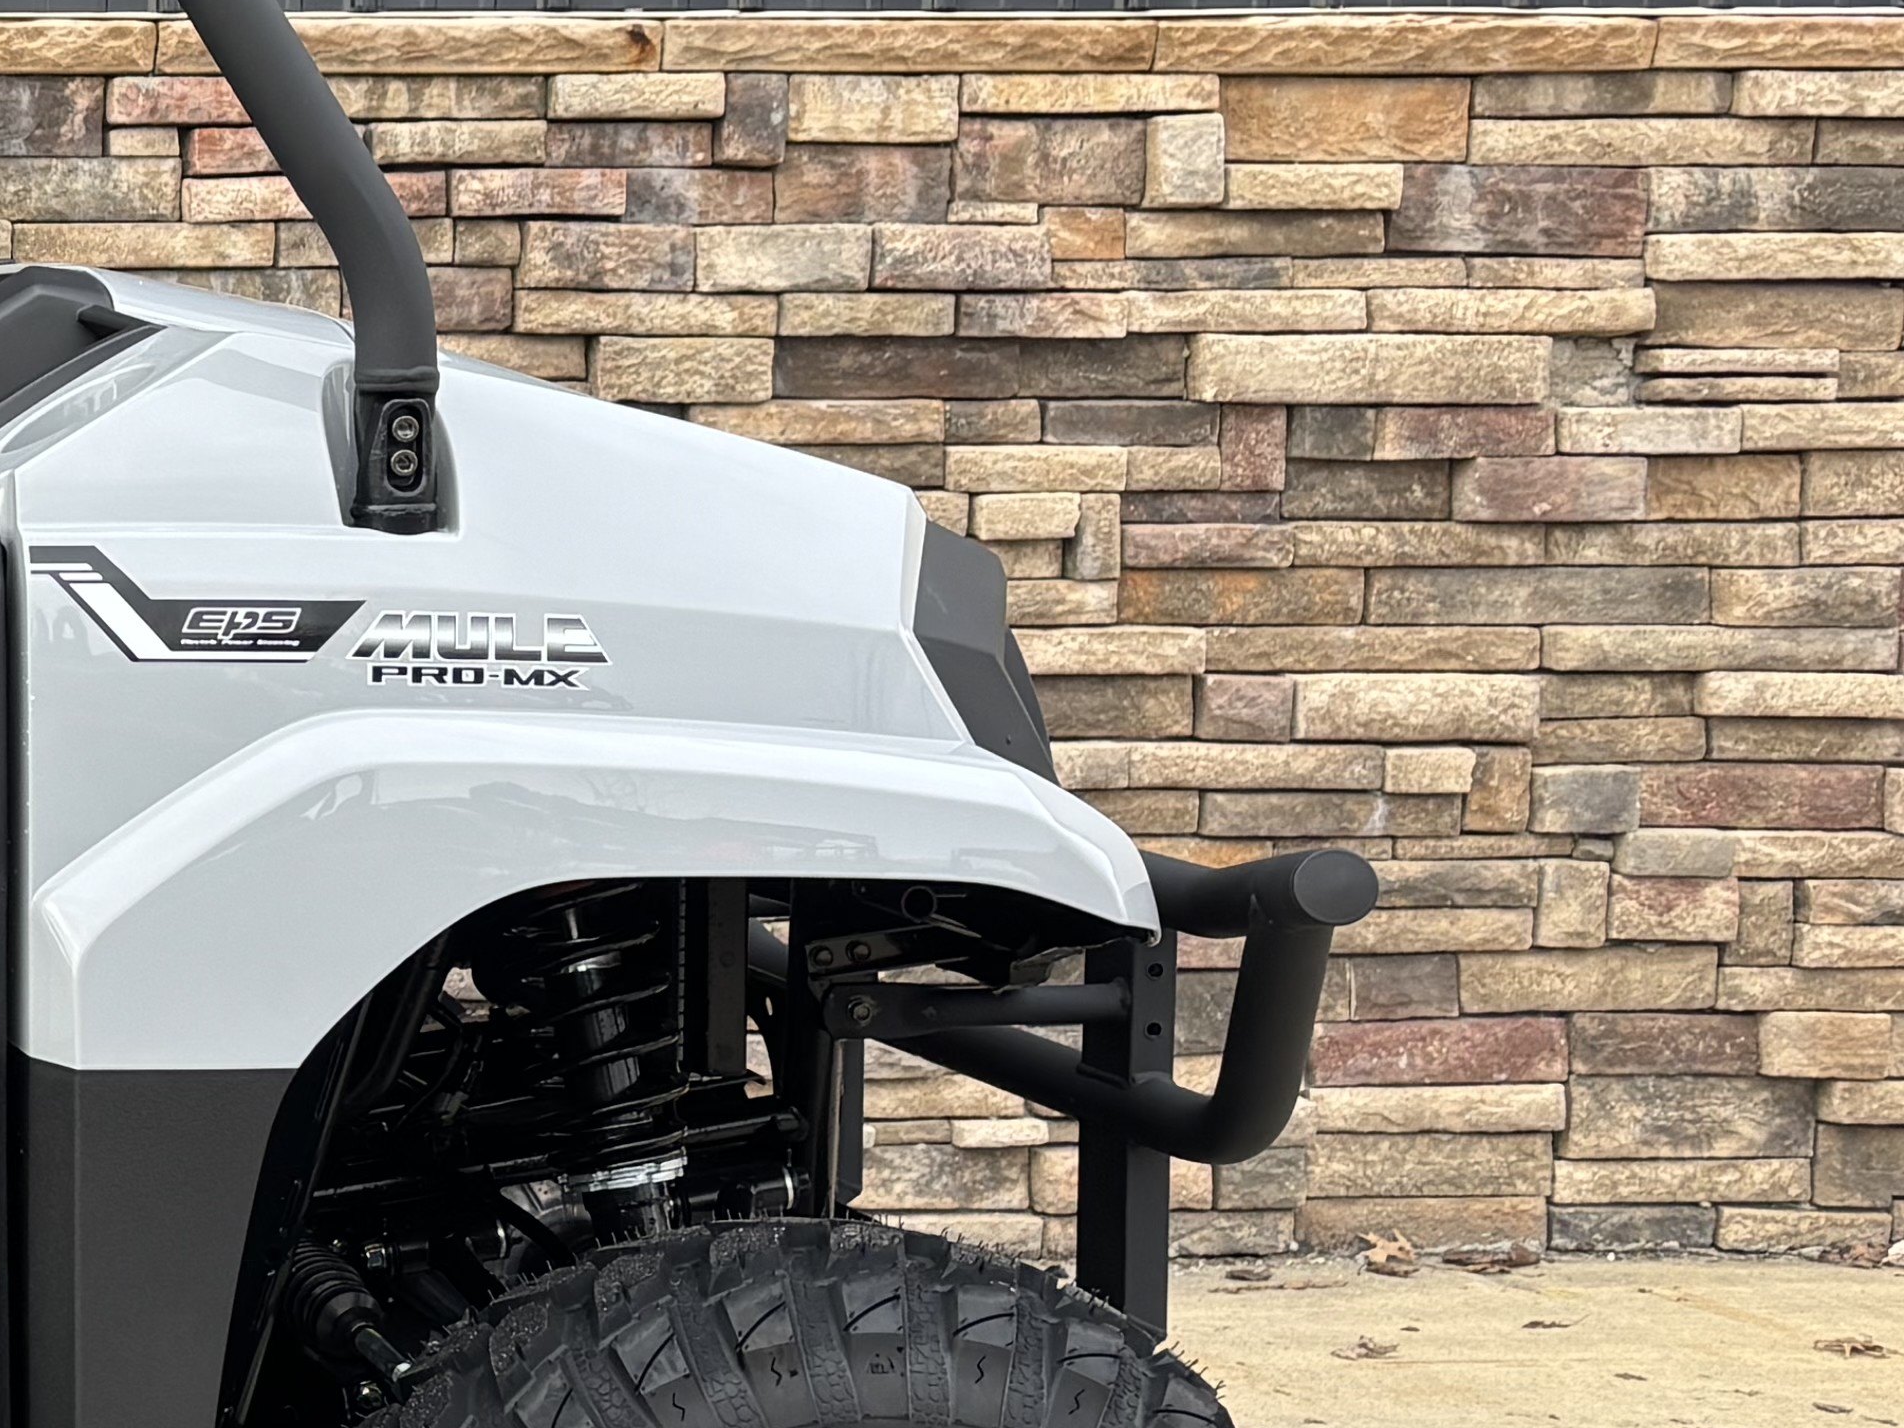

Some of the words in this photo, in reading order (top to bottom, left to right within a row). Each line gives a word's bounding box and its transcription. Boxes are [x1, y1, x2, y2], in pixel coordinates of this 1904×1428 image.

[183, 608, 300, 638] EPS
[348, 612, 610, 663] MULE
[371, 665, 586, 688] PRO-MX
